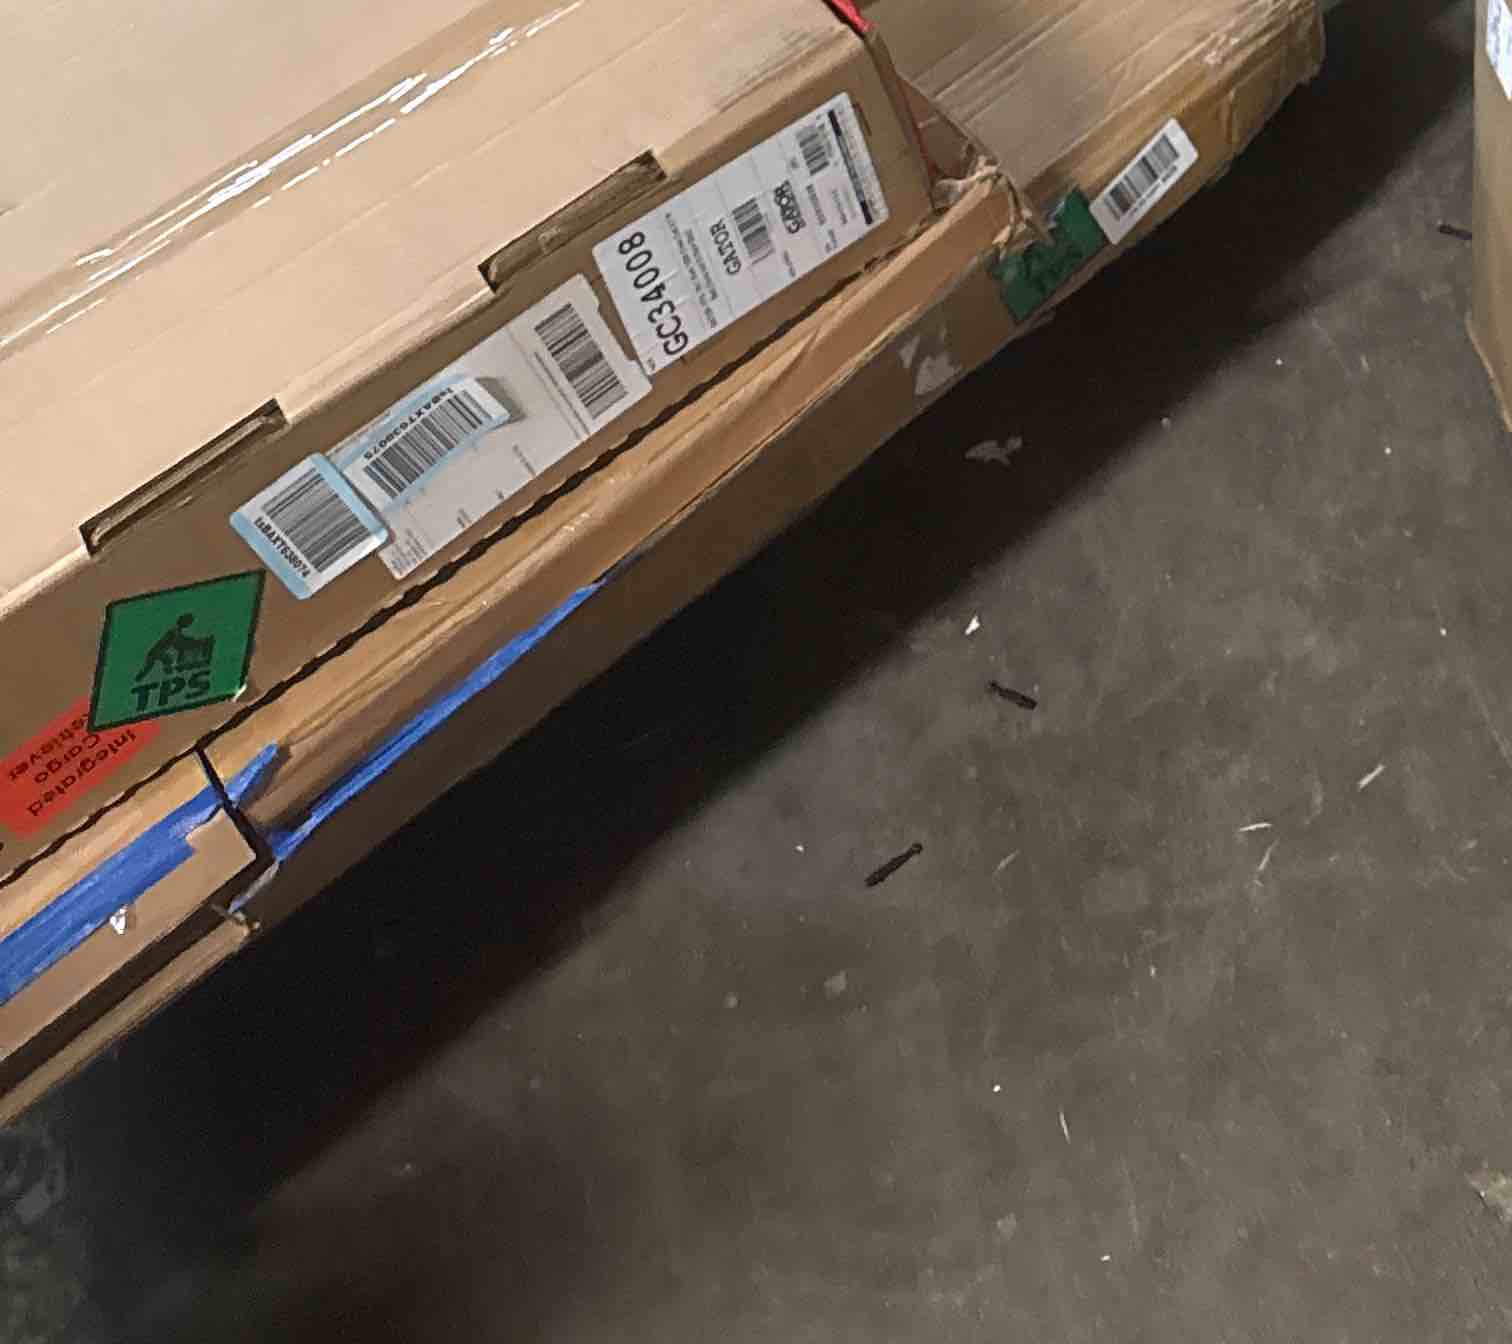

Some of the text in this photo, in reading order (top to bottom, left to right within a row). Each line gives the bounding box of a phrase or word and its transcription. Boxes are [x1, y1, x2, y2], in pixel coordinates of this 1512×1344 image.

[710, 219, 743, 276] GATOR
[617, 230, 690, 358] GC34008
[131, 668, 213, 714] TPS
[27, 729, 137, 817] Integrated
[32, 730, 102, 782] Cargo
